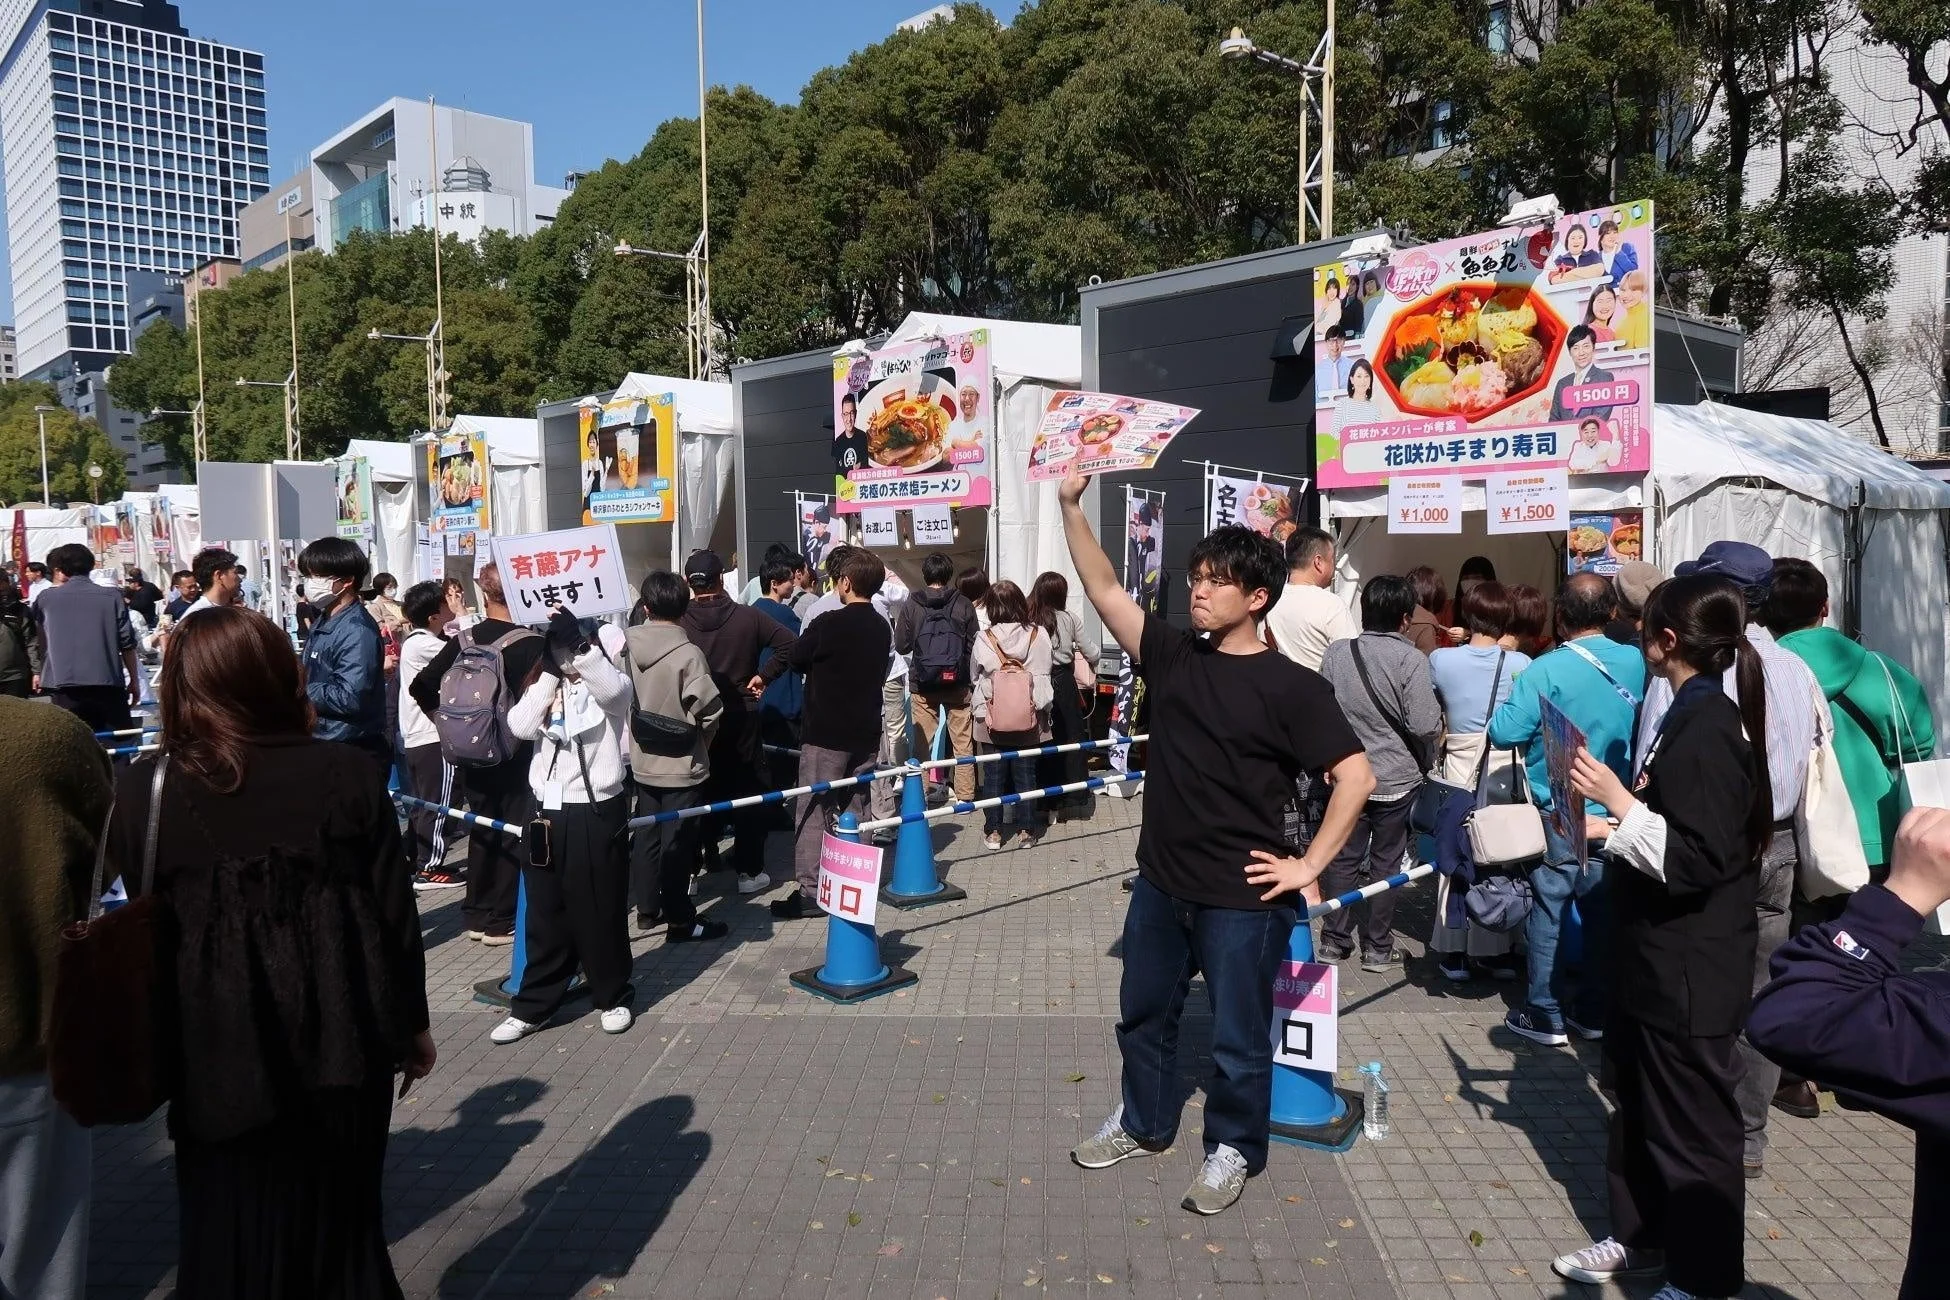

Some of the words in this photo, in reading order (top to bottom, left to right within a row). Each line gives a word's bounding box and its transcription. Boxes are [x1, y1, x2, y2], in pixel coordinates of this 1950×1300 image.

[439, 202, 476, 220] 中統
[1461, 250, 1519, 281] 魚魚丸
[1573, 387, 1611, 403] 1500
[1614, 384, 1630, 400] 円
[1384, 431, 1558, 467] 花咲か手まり寿司
[859, 478, 961, 500] 究極の天然塩ラーメン
[1401, 507, 1449, 522] ¥1,000
[1501, 504, 1555, 521] ¥1,500
[865, 521, 893, 534] お渡し口
[916, 518, 949, 532] ご注文口
[510, 544, 606, 580] 斉藤アナ
[820, 874, 862, 916] 出口
[1272, 978, 1326, 999] まり寿司
[1281, 1018, 1313, 1060] 口
